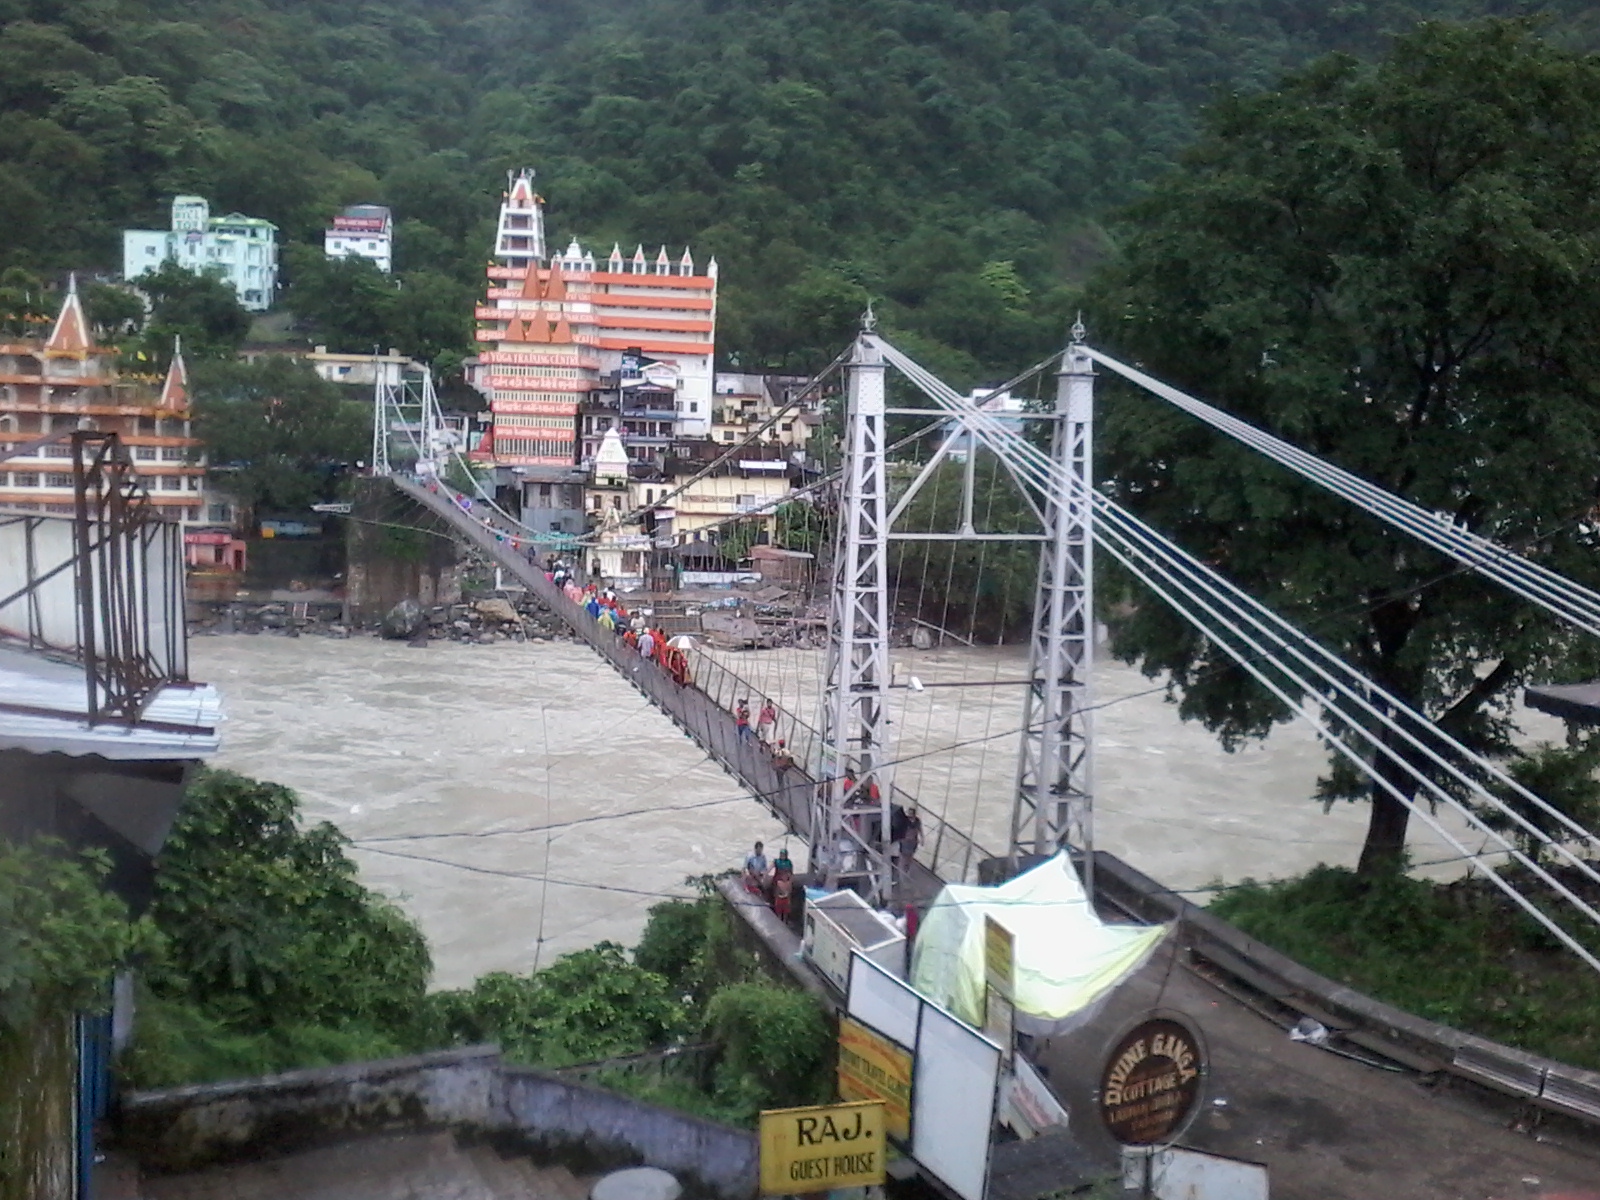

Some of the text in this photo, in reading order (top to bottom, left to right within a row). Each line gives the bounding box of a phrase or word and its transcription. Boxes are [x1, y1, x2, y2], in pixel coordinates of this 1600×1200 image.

[490, 352, 513, 363] YOGA
[514, 353, 550, 364] TRAINING
[1104, 1039, 1148, 1105] DIVINE
[1151, 1033, 1197, 1084] GANGA
[1123, 1073, 1176, 1101] COTTAGE
[796, 1112, 872, 1147] RAJ.
[790, 1152, 875, 1181] GUEST HOUSE
